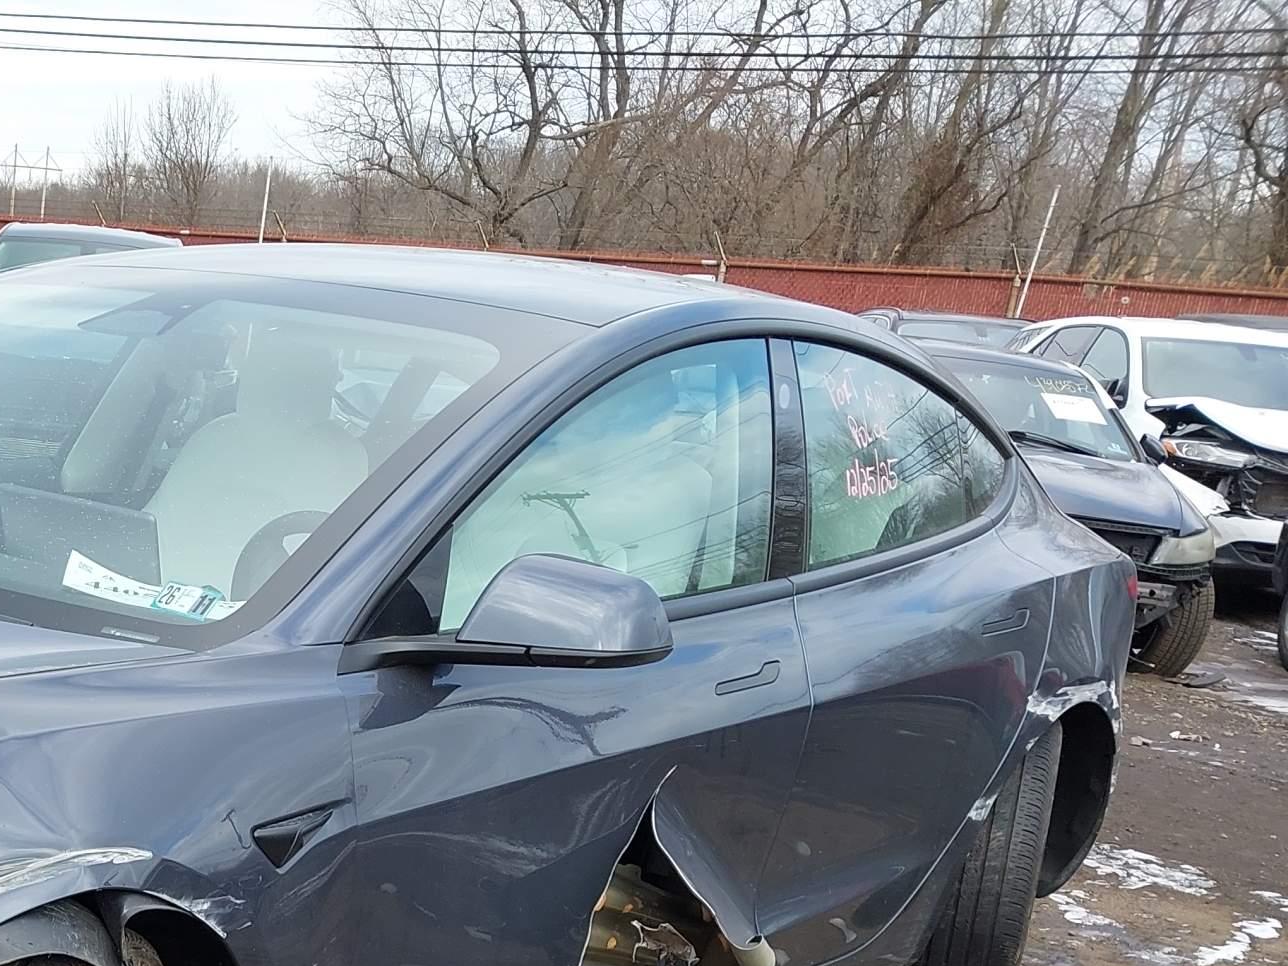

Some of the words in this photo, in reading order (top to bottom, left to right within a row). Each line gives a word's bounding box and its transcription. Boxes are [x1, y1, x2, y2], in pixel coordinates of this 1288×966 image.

[846, 448, 899, 500] 12/25/25
[159, 586, 182, 605] 26
[192, 595, 216, 615] 11
